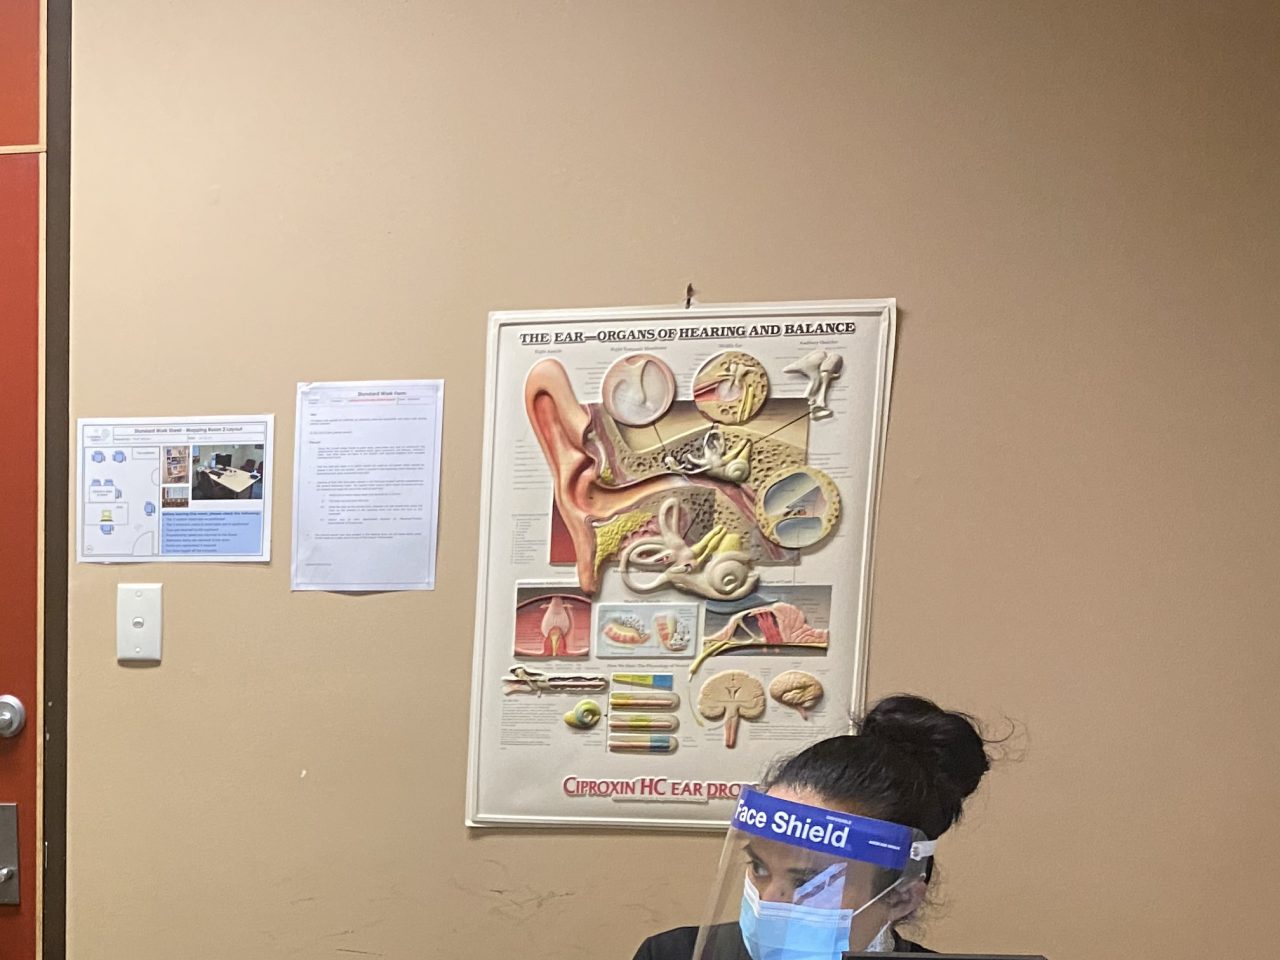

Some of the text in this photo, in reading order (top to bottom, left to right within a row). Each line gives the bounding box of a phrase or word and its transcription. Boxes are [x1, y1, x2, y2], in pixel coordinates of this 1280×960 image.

[520, 333, 550, 344] THE
[658, 328, 677, 340] OF
[679, 326, 746, 339] HEARING
[749, 324, 781, 336] AND
[784, 322, 856, 335] BALANCE
[640, 778, 667, 796] HC
[671, 782, 703, 796] EAR
[707, 783, 742, 797] DRO
[771, 811, 850, 849] Shield
